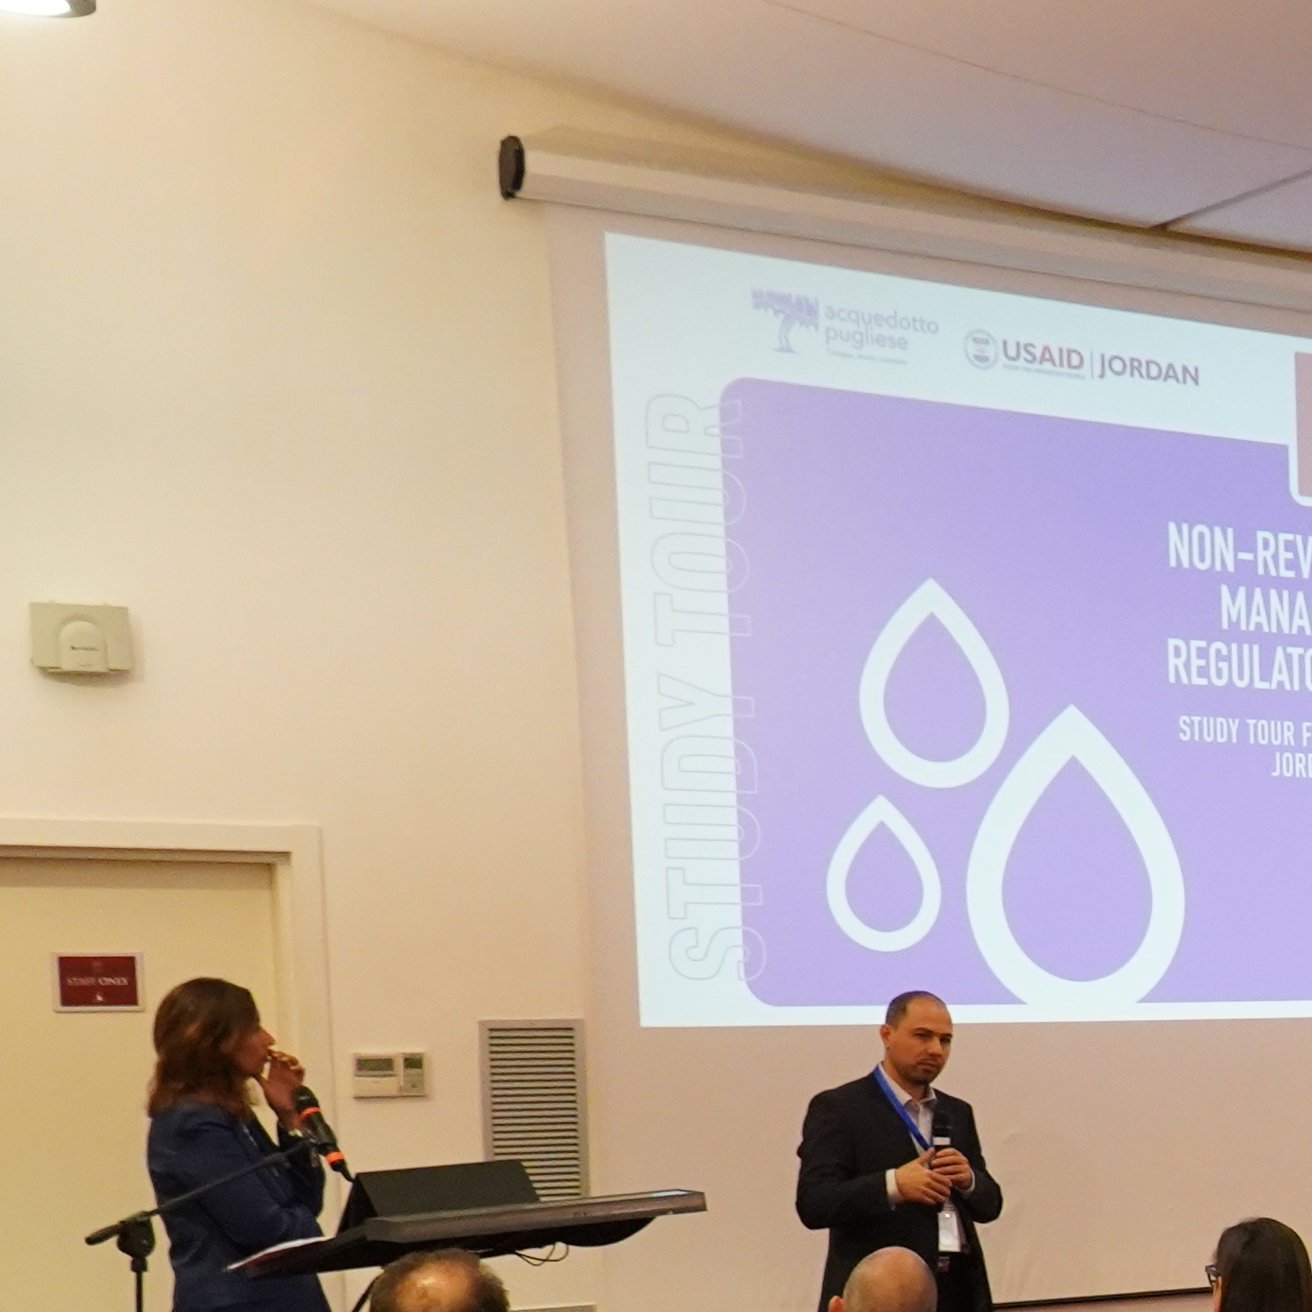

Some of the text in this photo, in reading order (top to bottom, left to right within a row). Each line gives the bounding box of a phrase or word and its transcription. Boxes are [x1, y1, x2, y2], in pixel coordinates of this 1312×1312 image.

[825, 305, 939, 334] acquedotto
[826, 325, 908, 350] pugliese
[1002, 339, 1084, 370] USAID
[1098, 353, 1200, 387] JORDAN
[644, 393, 766, 981] STUDY TOUR
[1178, 715, 1239, 744] STUDY
[1246, 718, 1295, 746] TOUR
